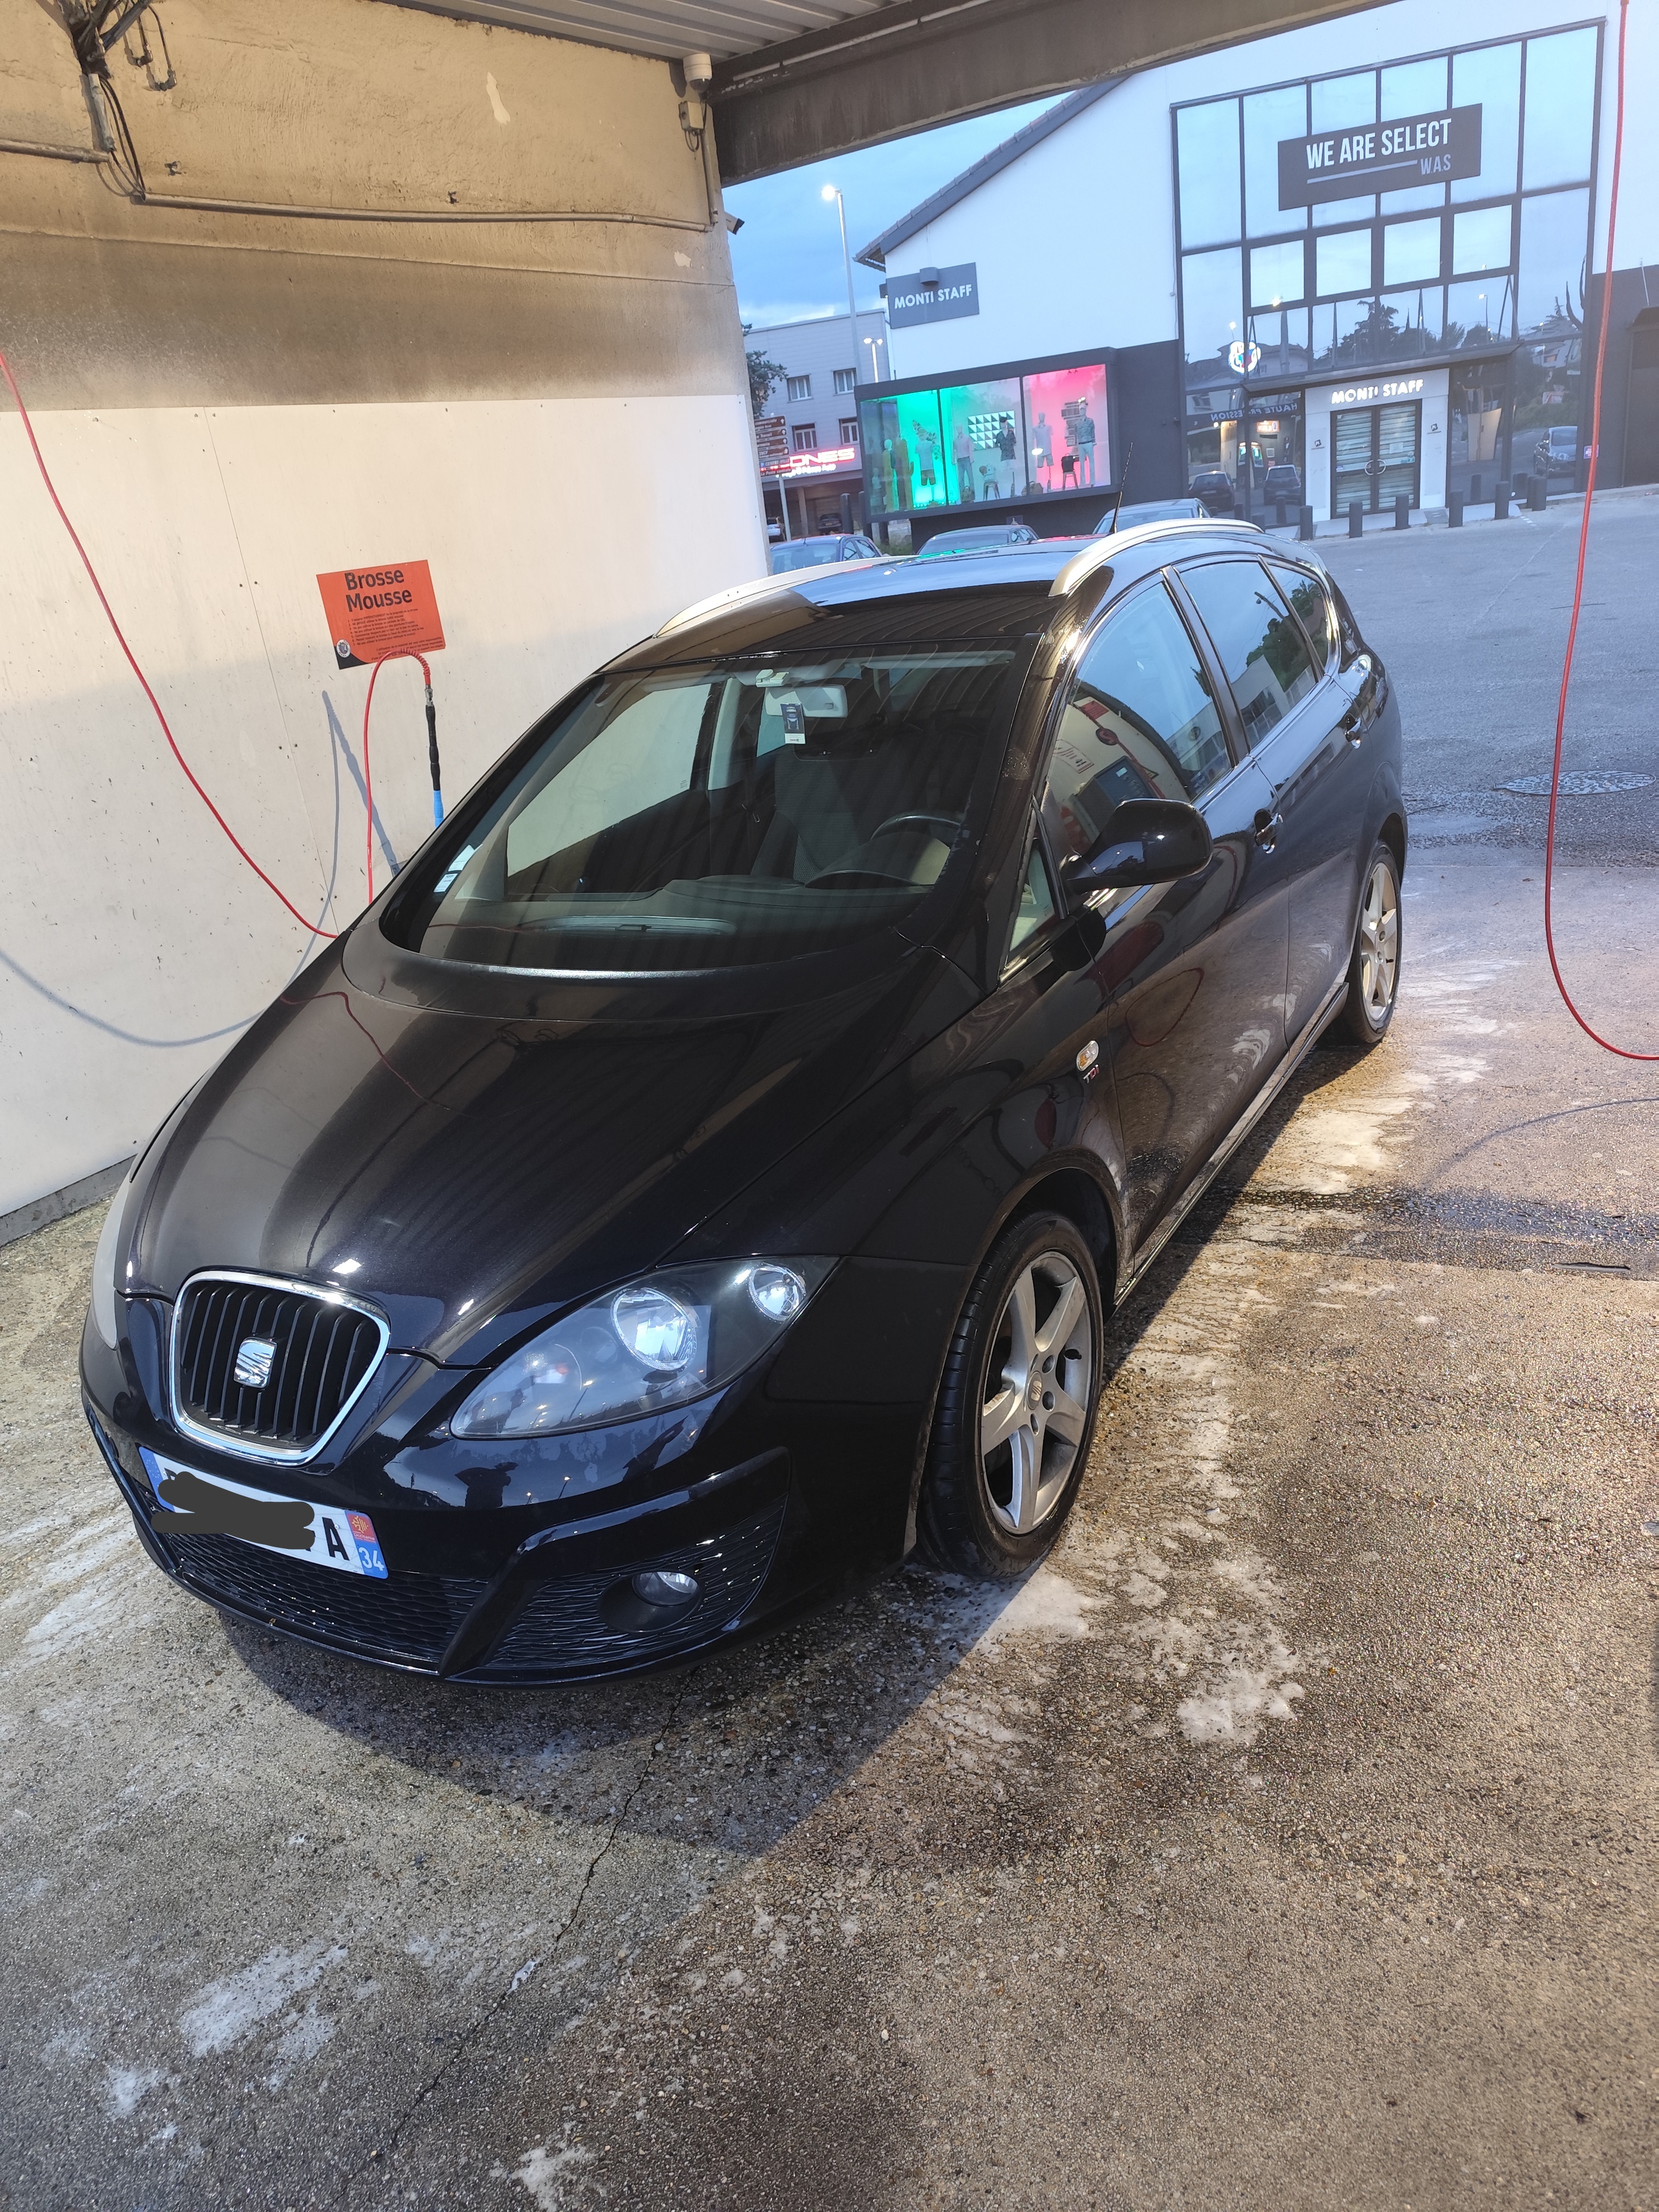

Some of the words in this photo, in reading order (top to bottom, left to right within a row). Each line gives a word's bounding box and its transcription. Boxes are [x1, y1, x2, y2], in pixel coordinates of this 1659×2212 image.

[1307, 140, 1334, 169] WE
[1339, 132, 1376, 164] ARE
[1381, 118, 1452, 156] SELECT
[895, 291, 934, 309] MONTI
[937, 284, 972, 301] STAFF
[1332, 386, 1379, 404] MONTI
[1382, 379, 1424, 397] STAFF
[344, 569, 404, 591] Brosse
[345, 589, 413, 613] Mousse
[1083, 1064, 1099, 1084] TDI
[353, 1533, 375, 1541] Occitanie
[358, 1547, 385, 1572] 34
